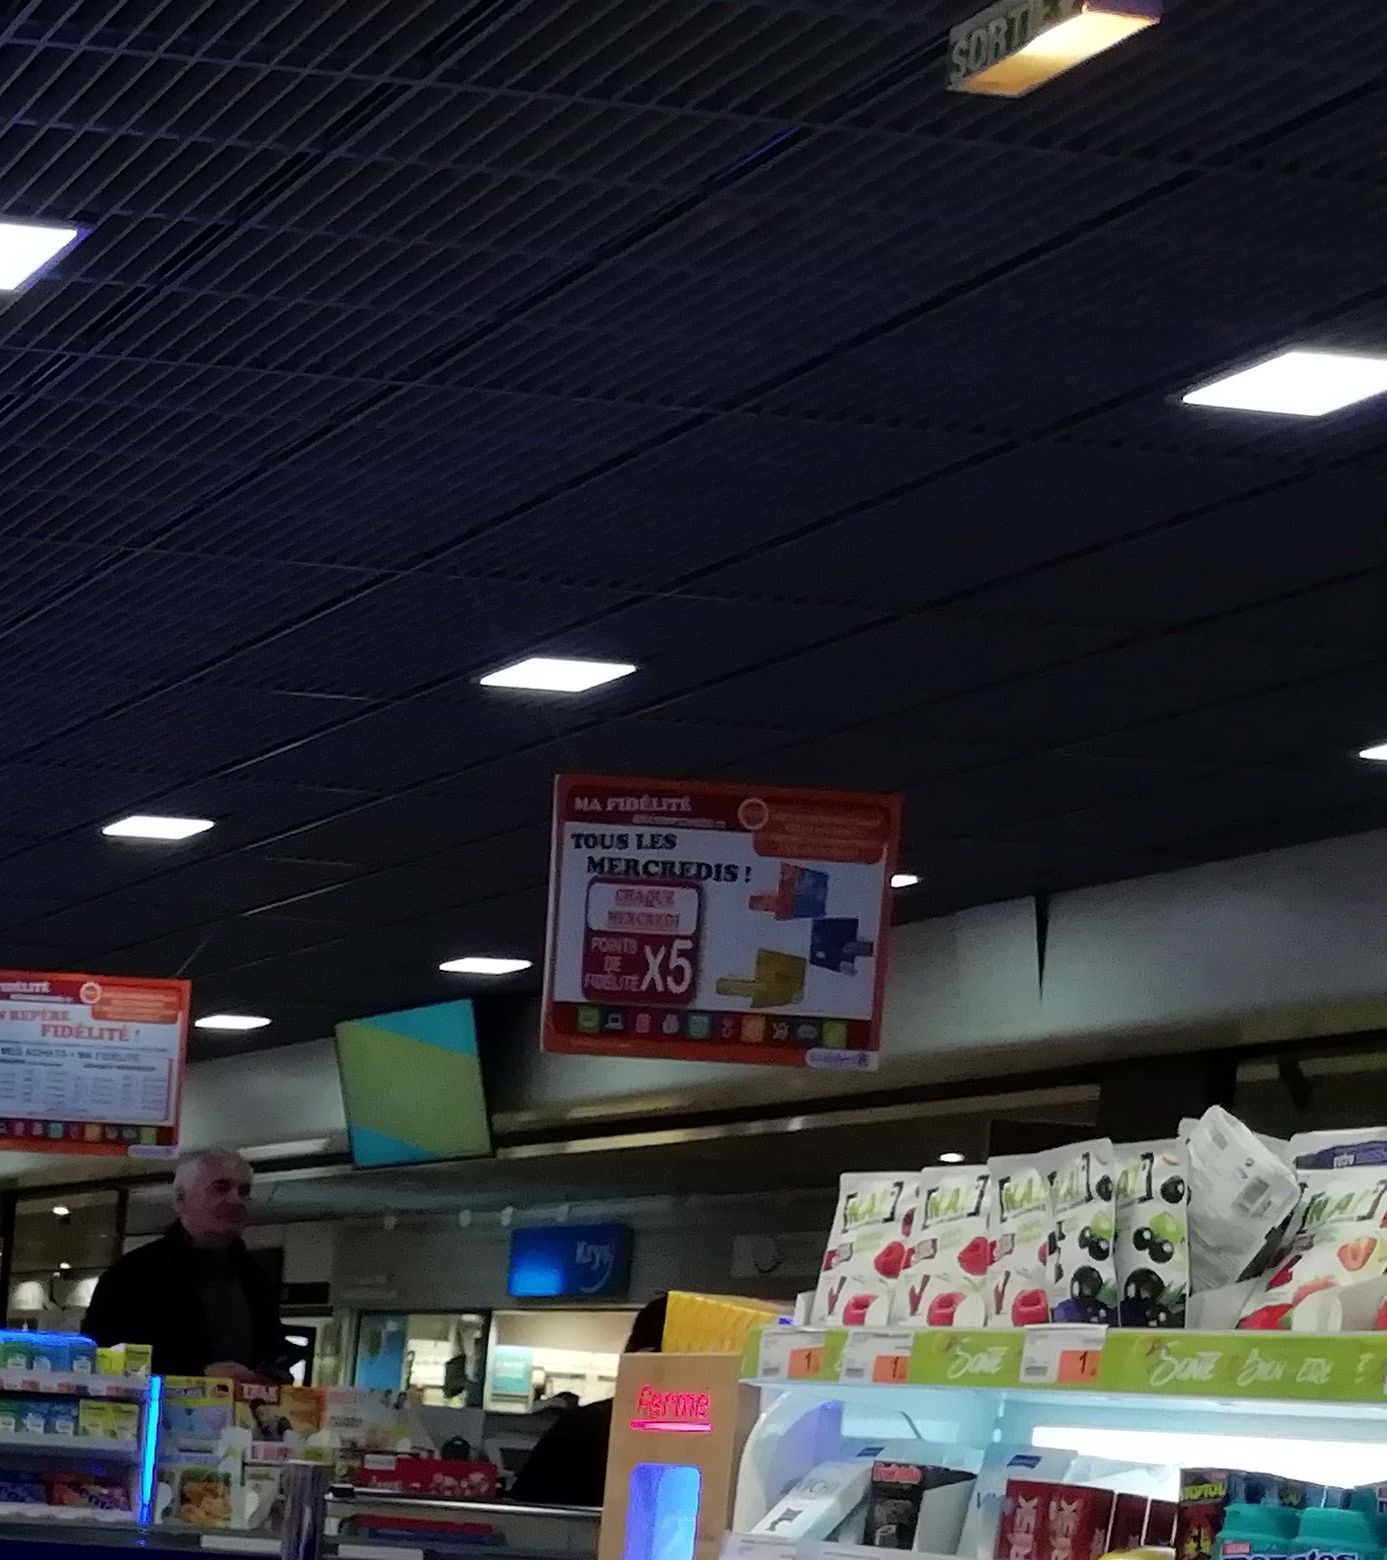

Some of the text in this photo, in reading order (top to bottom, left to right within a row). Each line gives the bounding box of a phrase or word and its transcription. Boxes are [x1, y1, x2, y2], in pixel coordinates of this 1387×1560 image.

[571, 833, 677, 851] TOUS LES
[587, 856, 738, 883] MERCREDIS
